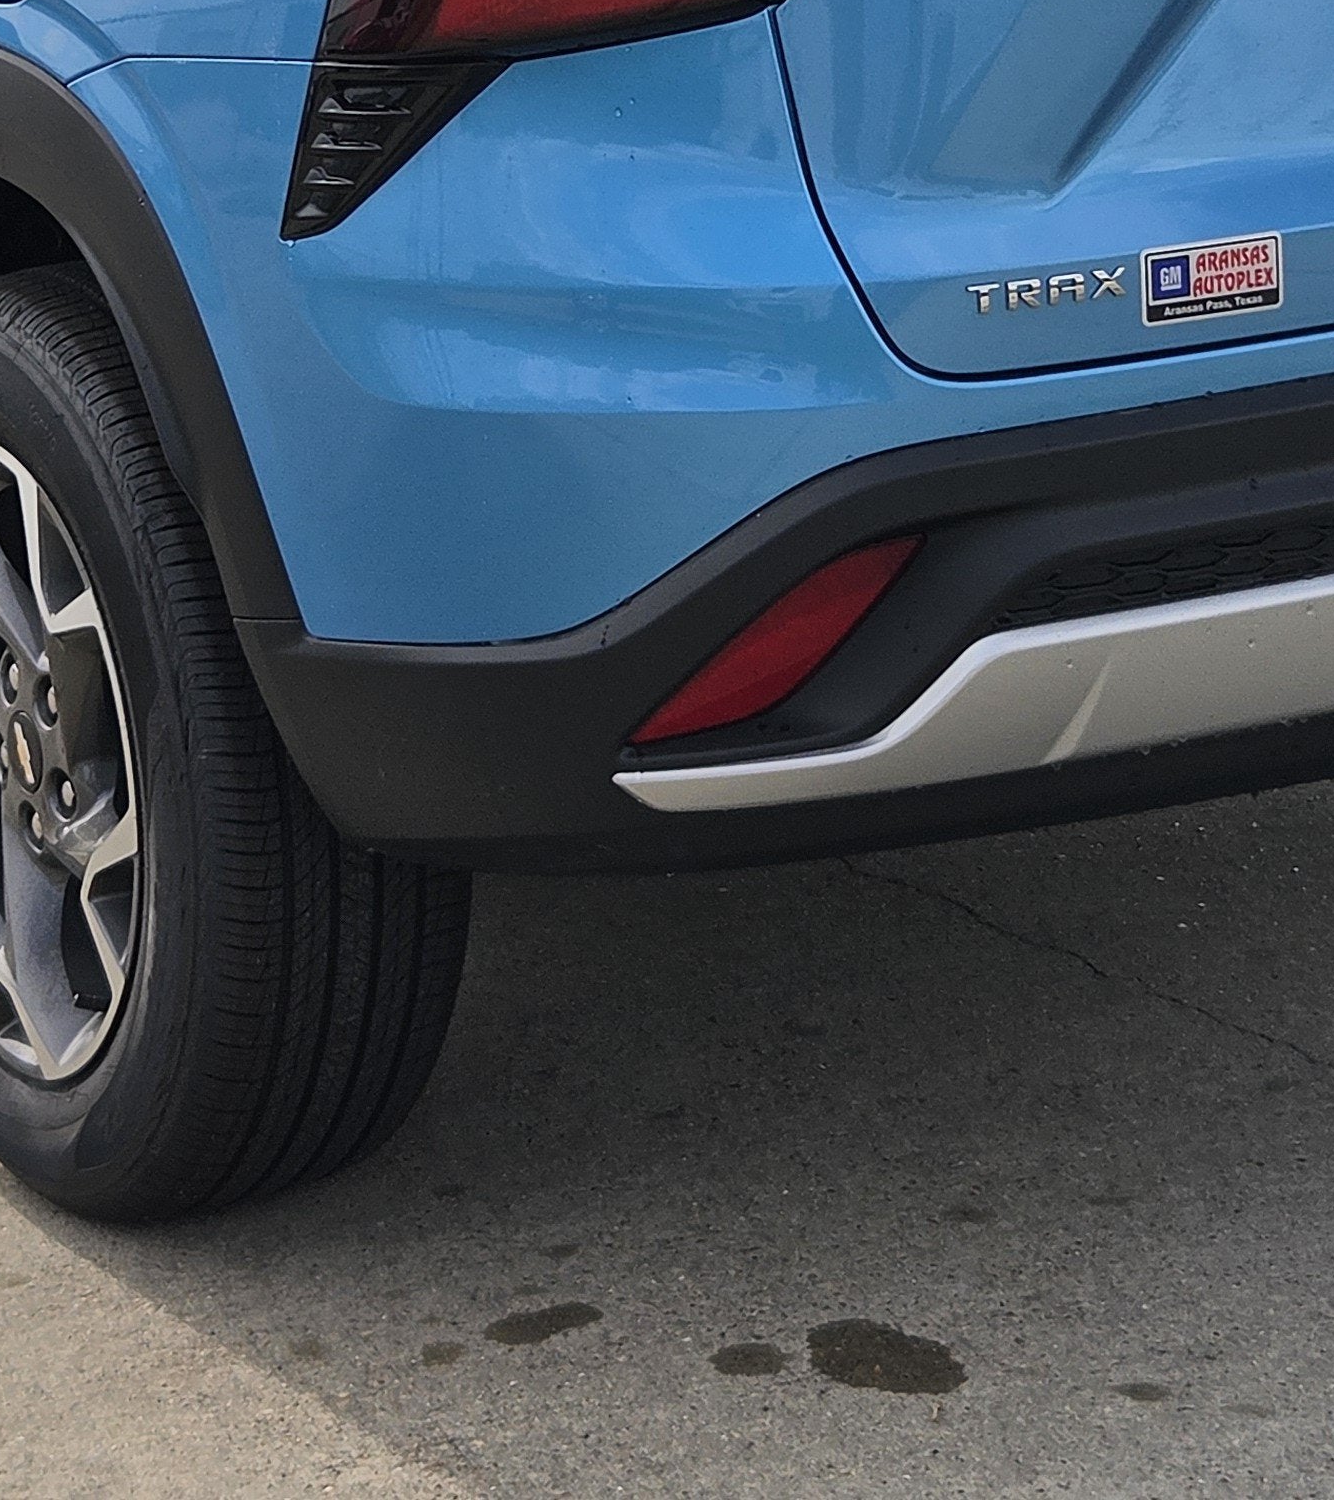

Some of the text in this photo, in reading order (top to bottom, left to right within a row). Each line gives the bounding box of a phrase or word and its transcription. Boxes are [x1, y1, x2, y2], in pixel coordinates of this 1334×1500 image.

[1195, 243, 1269, 274] ARANSAS
[966, 265, 1127, 314] TRAX
[1159, 265, 1182, 290] GM
[1192, 267, 1275, 298] AUTOPLEX
[1163, 301, 1204, 316] Aransas
[1234, 294, 1264, 306] Texas
